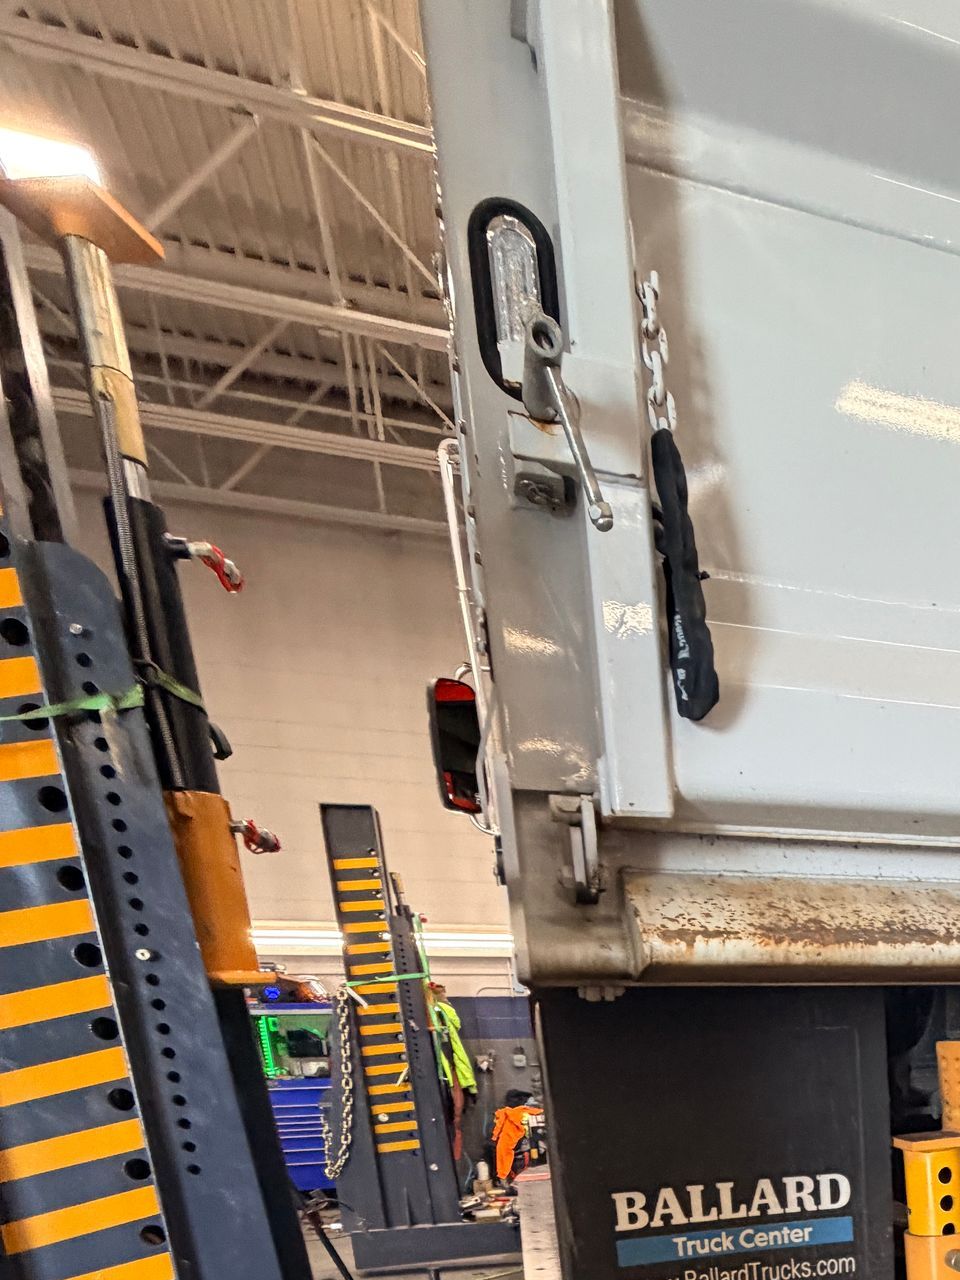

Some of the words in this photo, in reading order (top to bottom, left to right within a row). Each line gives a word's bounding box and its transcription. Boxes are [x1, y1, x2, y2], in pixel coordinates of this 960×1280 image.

[611, 1172, 851, 1232] BALLARD
[672, 1231, 735, 1257] Truck
[739, 1225, 813, 1248] Center
